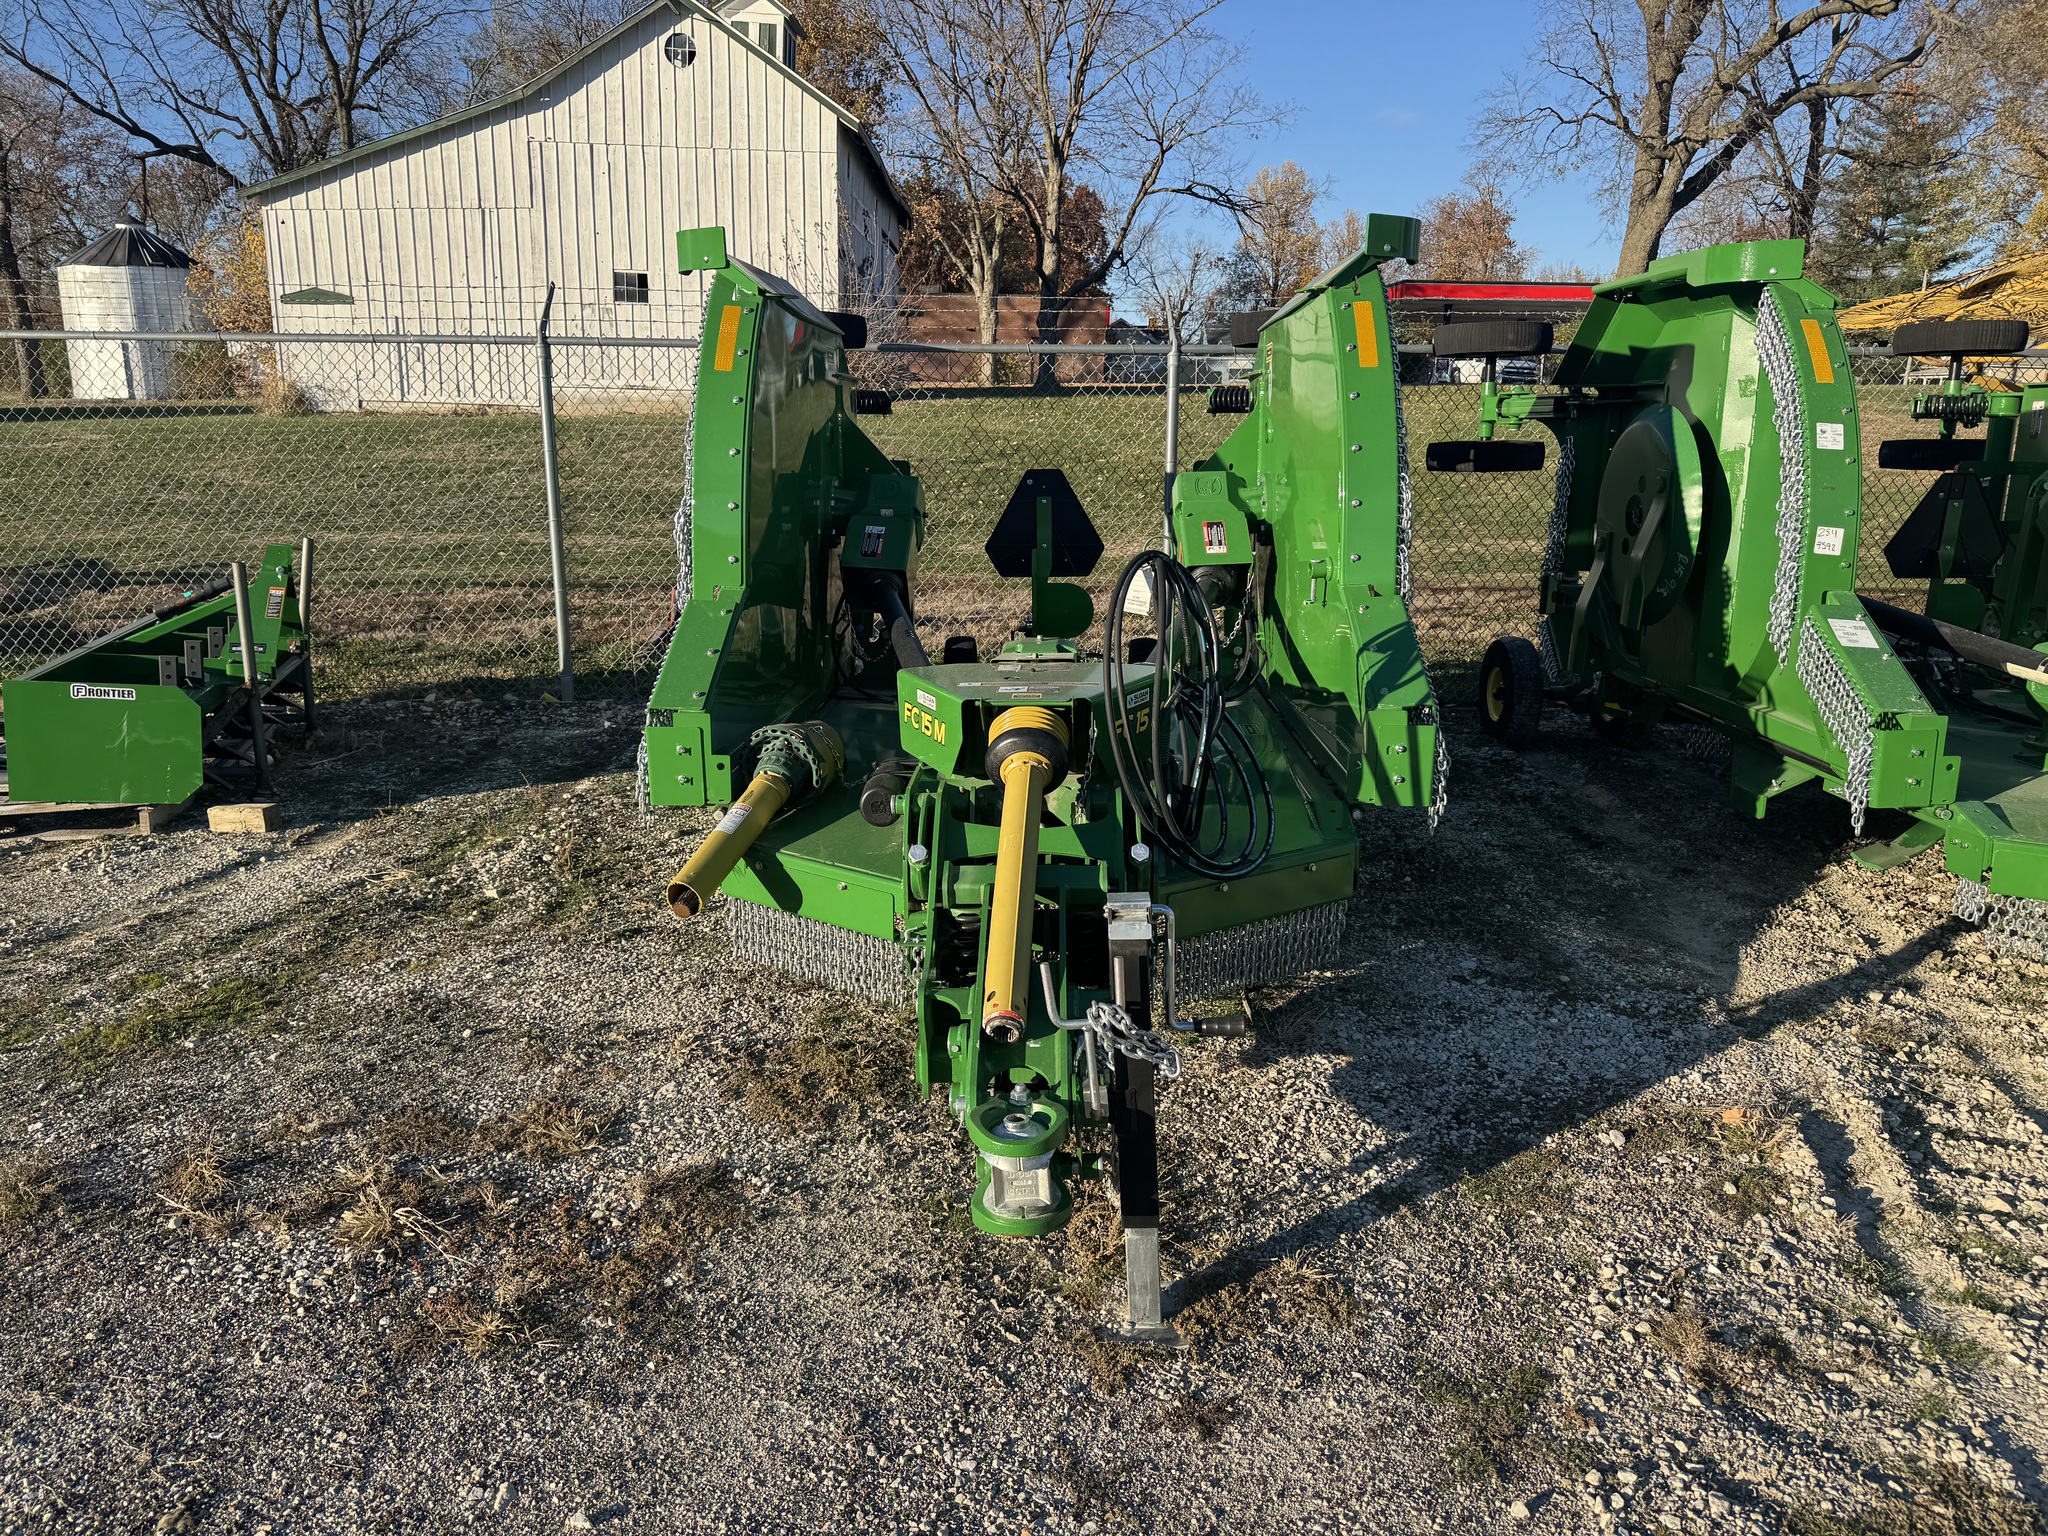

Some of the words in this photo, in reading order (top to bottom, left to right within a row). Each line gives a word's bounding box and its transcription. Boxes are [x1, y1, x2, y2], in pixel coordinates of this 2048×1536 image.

[1818, 527, 1838, 539] 254
[1816, 541, 1836, 552] 7592
[72, 685, 134, 700] FRONTIER
[1133, 689, 1149, 700] SLOAN
